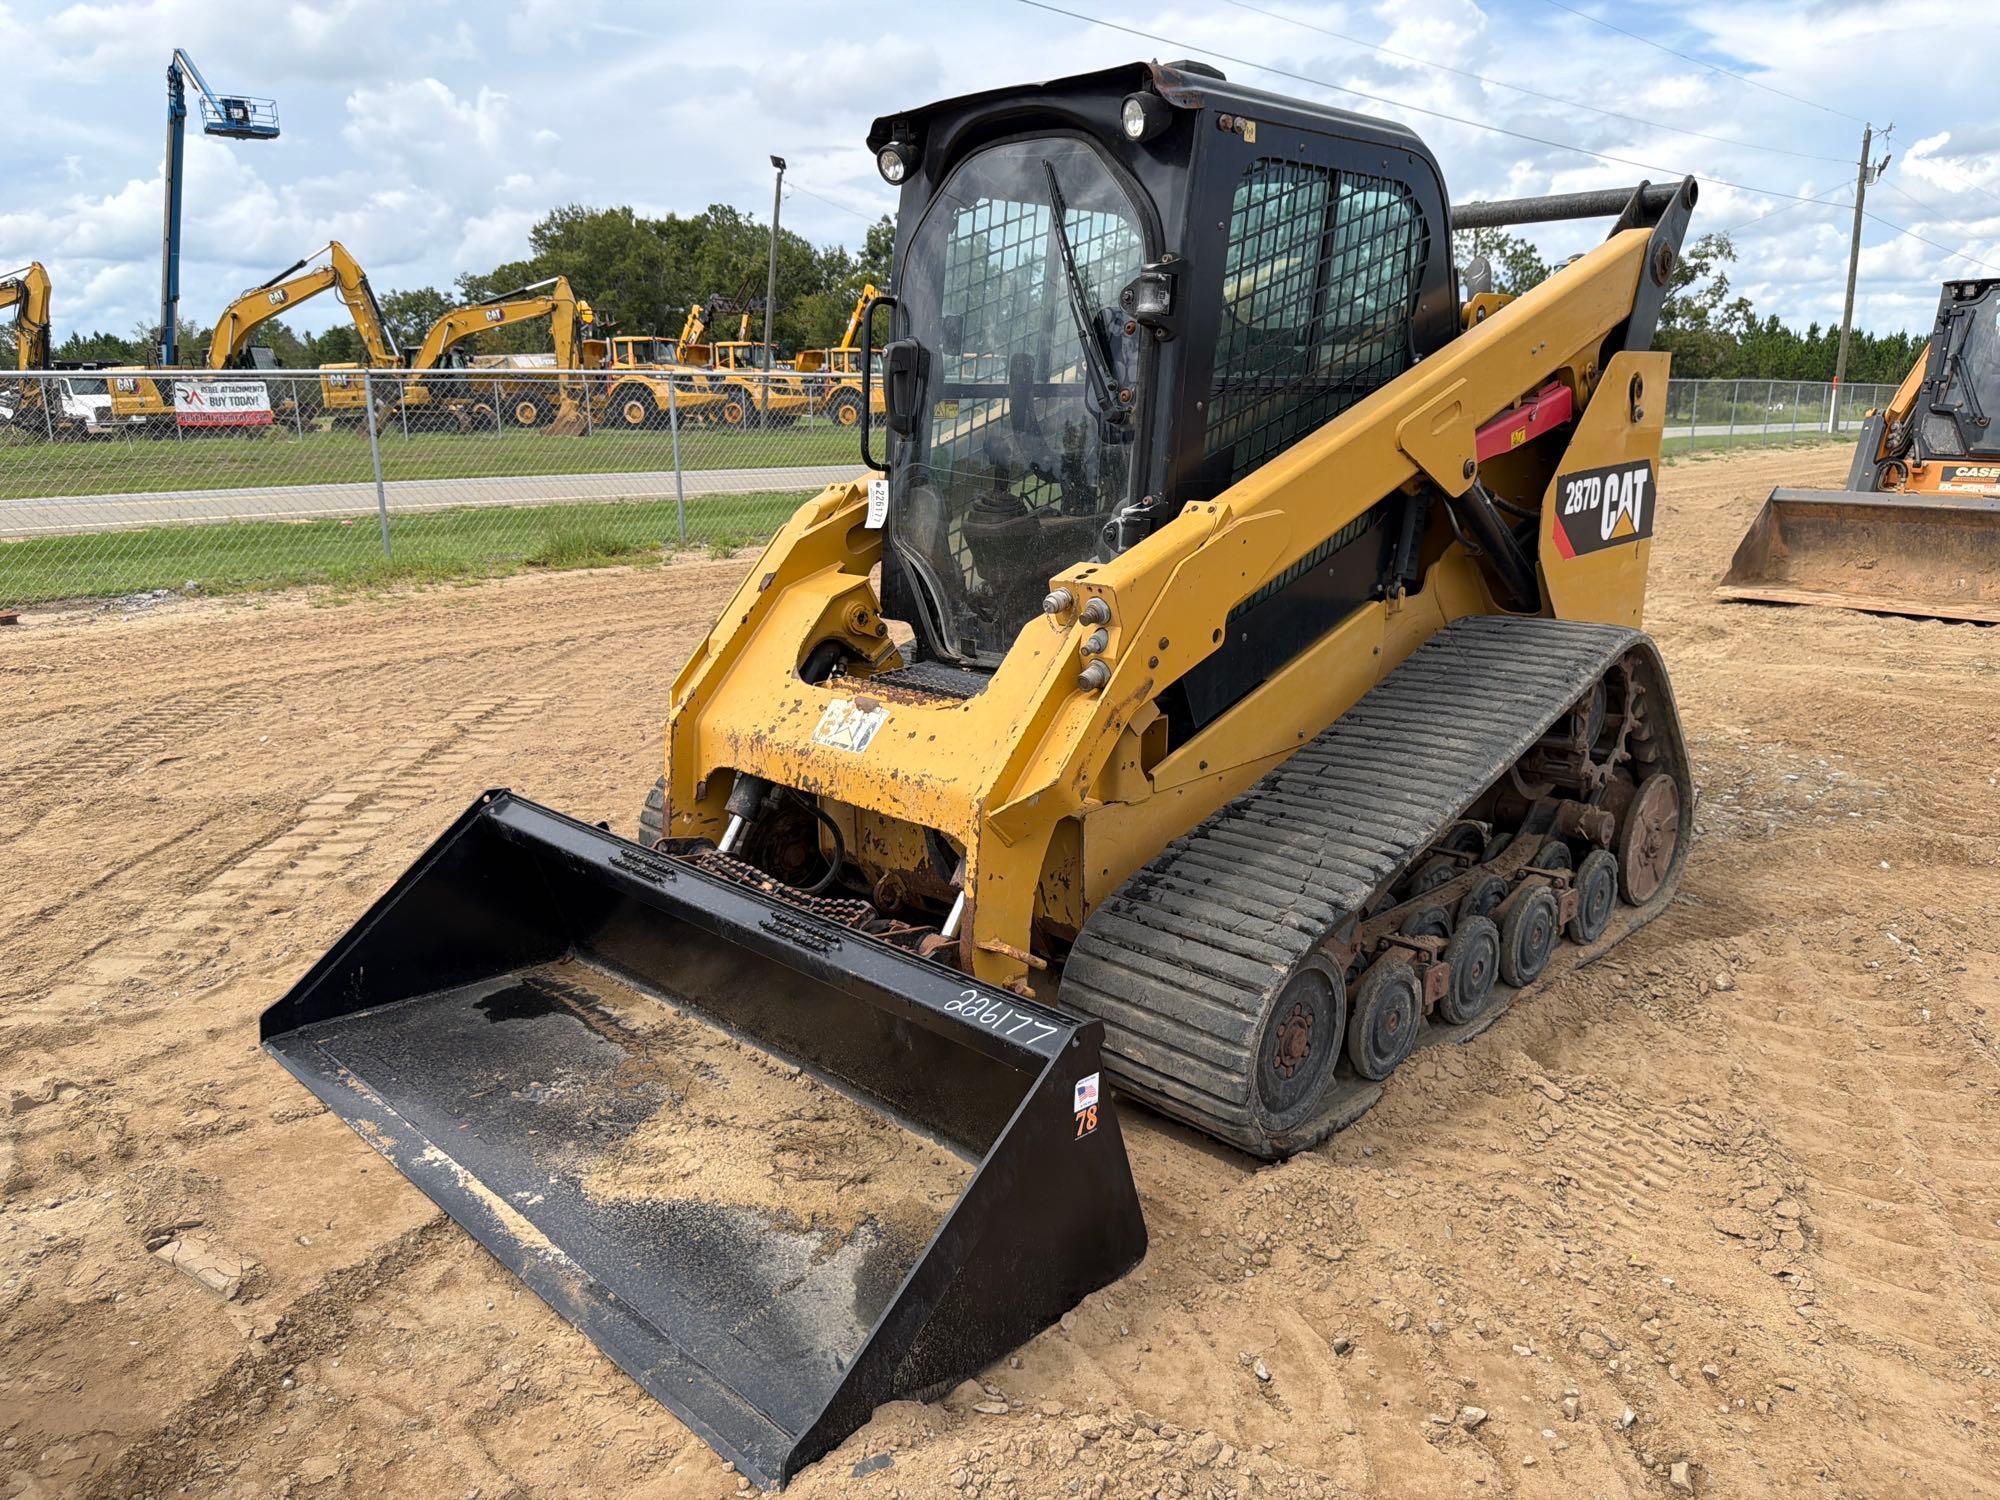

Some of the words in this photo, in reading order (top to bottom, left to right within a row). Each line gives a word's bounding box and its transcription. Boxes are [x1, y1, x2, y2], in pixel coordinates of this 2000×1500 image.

[268, 289, 285, 305] CAT
[485, 309, 501, 321] CAT
[116, 377, 135, 391] CAT
[209, 396, 226, 407] BUY
[228, 395, 260, 406] TODAY!
[1955, 467, 2000, 478] CASE
[873, 490, 885, 523] 226177
[1564, 476, 1601, 515] 287D
[1600, 468, 1649, 541] CAT
[944, 989, 1058, 1044] 226177
[1075, 1104, 1098, 1137] 78
